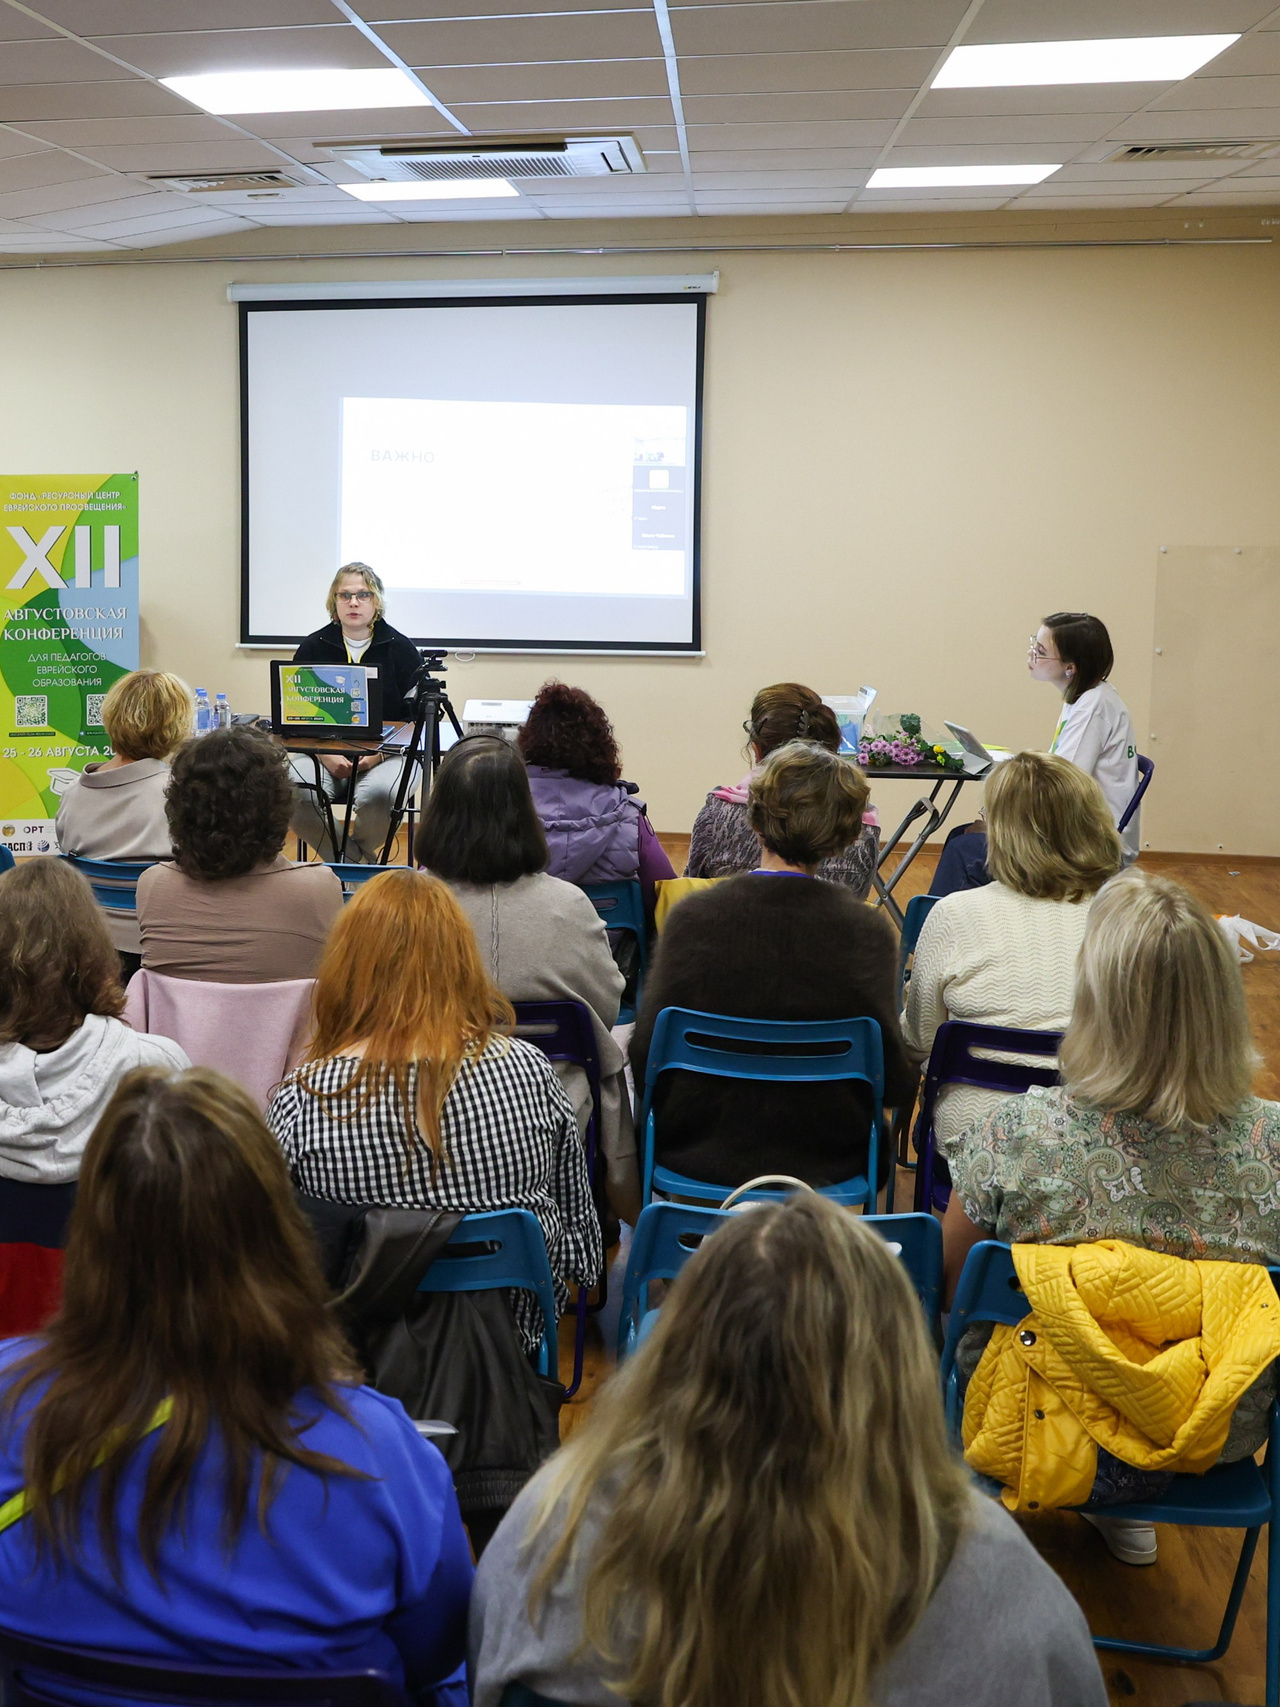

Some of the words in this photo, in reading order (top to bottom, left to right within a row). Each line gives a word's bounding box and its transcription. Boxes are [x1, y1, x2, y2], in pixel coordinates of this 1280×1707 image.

[371, 449, 435, 464] ВАЖНО
[10, 492, 36, 500] ФОНД
[96, 491, 120, 500] ЦЕНТР
[4, 503, 59, 512] ЕВРЕЙСКОГО
[61, 503, 127, 512] ПРОСВЕЩЕНИЯ»
[5, 524, 122, 590] XII
[3, 607, 127, 621] АВГУСТОВСКАЯ
[4, 627, 123, 641] КОНФЕРЕНЦИЯ
[28, 653, 48, 662] ДЛЯ
[50, 652, 107, 662] ПЕДАГОГОВ
[36, 664, 98, 674] ЕВРЕЙСКОГО
[32, 677, 102, 687] ОБРАЗОВАНИЯ
[286, 675, 301, 684] XII
[286, 696, 344, 704] КОНФЕРЕНЦИЯ
[2, 748, 17, 758] 25
[28, 747, 43, 758] 26
[46, 746, 100, 757] АВГУСТА
[103, 746, 117, 756] 20
[24, 826, 44, 834] ОРТ
